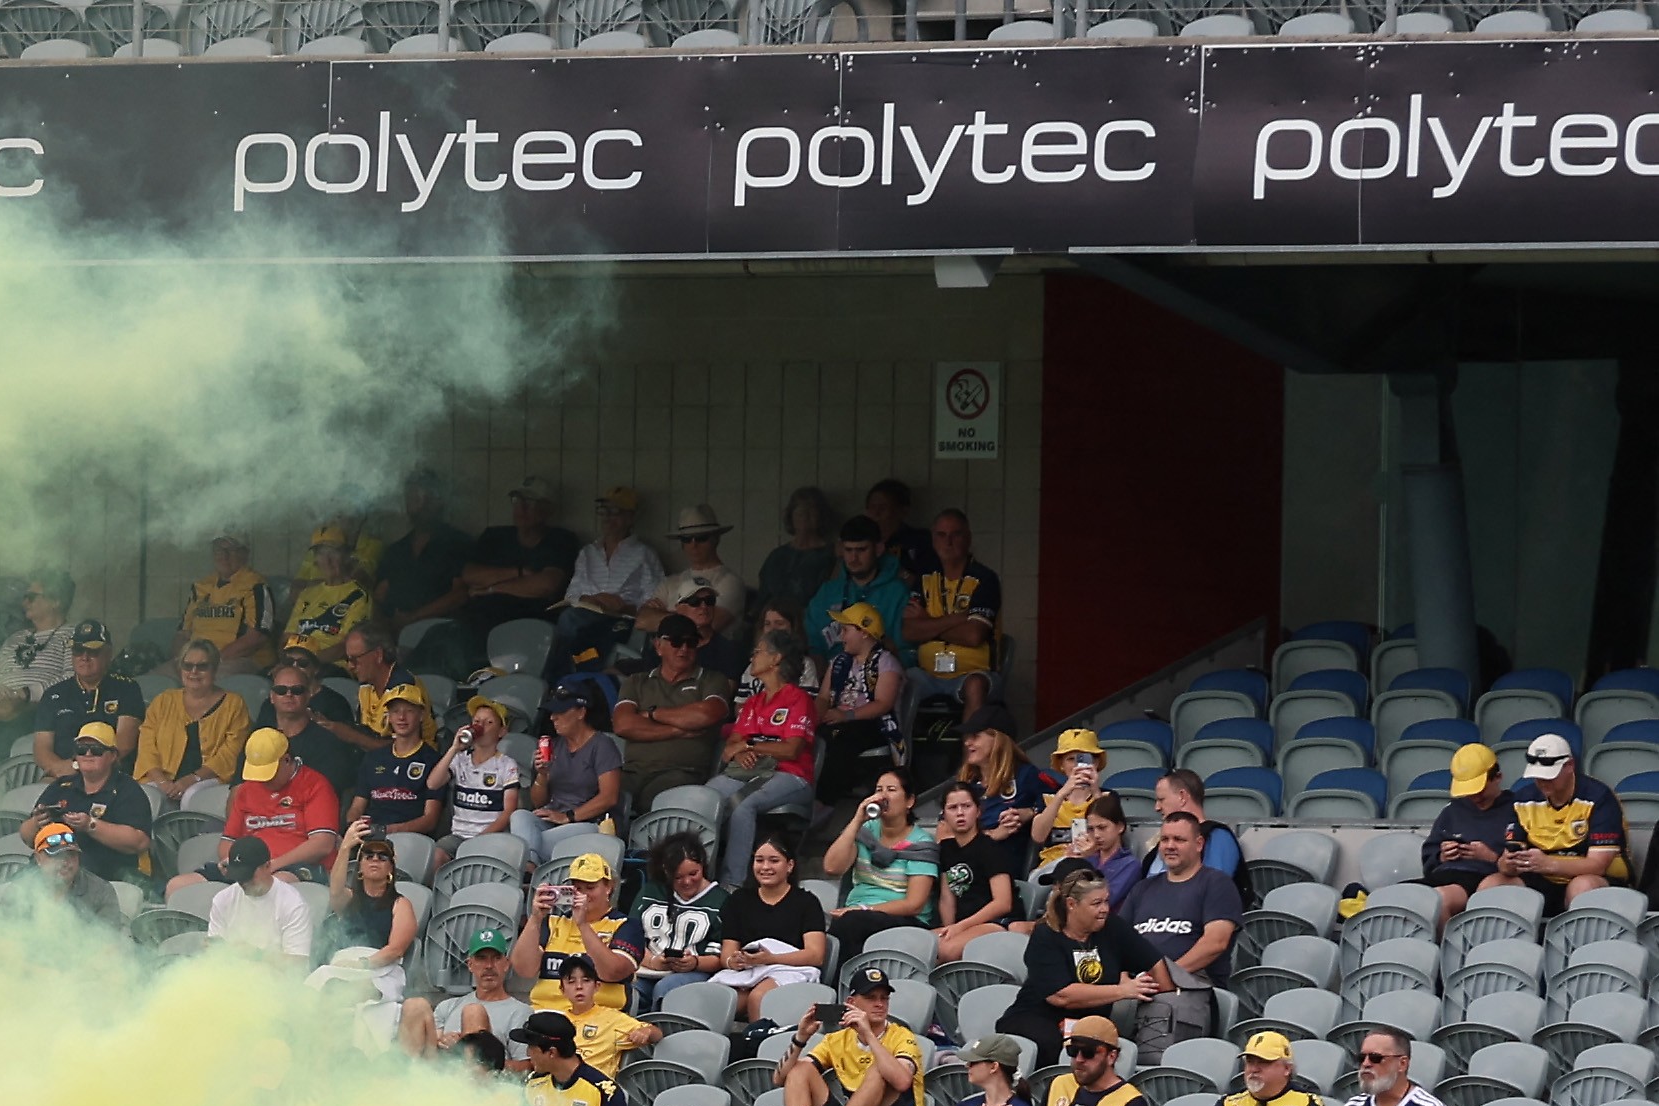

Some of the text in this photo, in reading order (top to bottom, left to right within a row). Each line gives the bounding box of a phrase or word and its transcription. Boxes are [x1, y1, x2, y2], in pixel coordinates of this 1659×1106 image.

[234, 111, 643, 213] polytec
[734, 102, 1157, 207] polytec
[938, 440, 996, 452] SMOKING
[958, 427, 976, 438] NO
